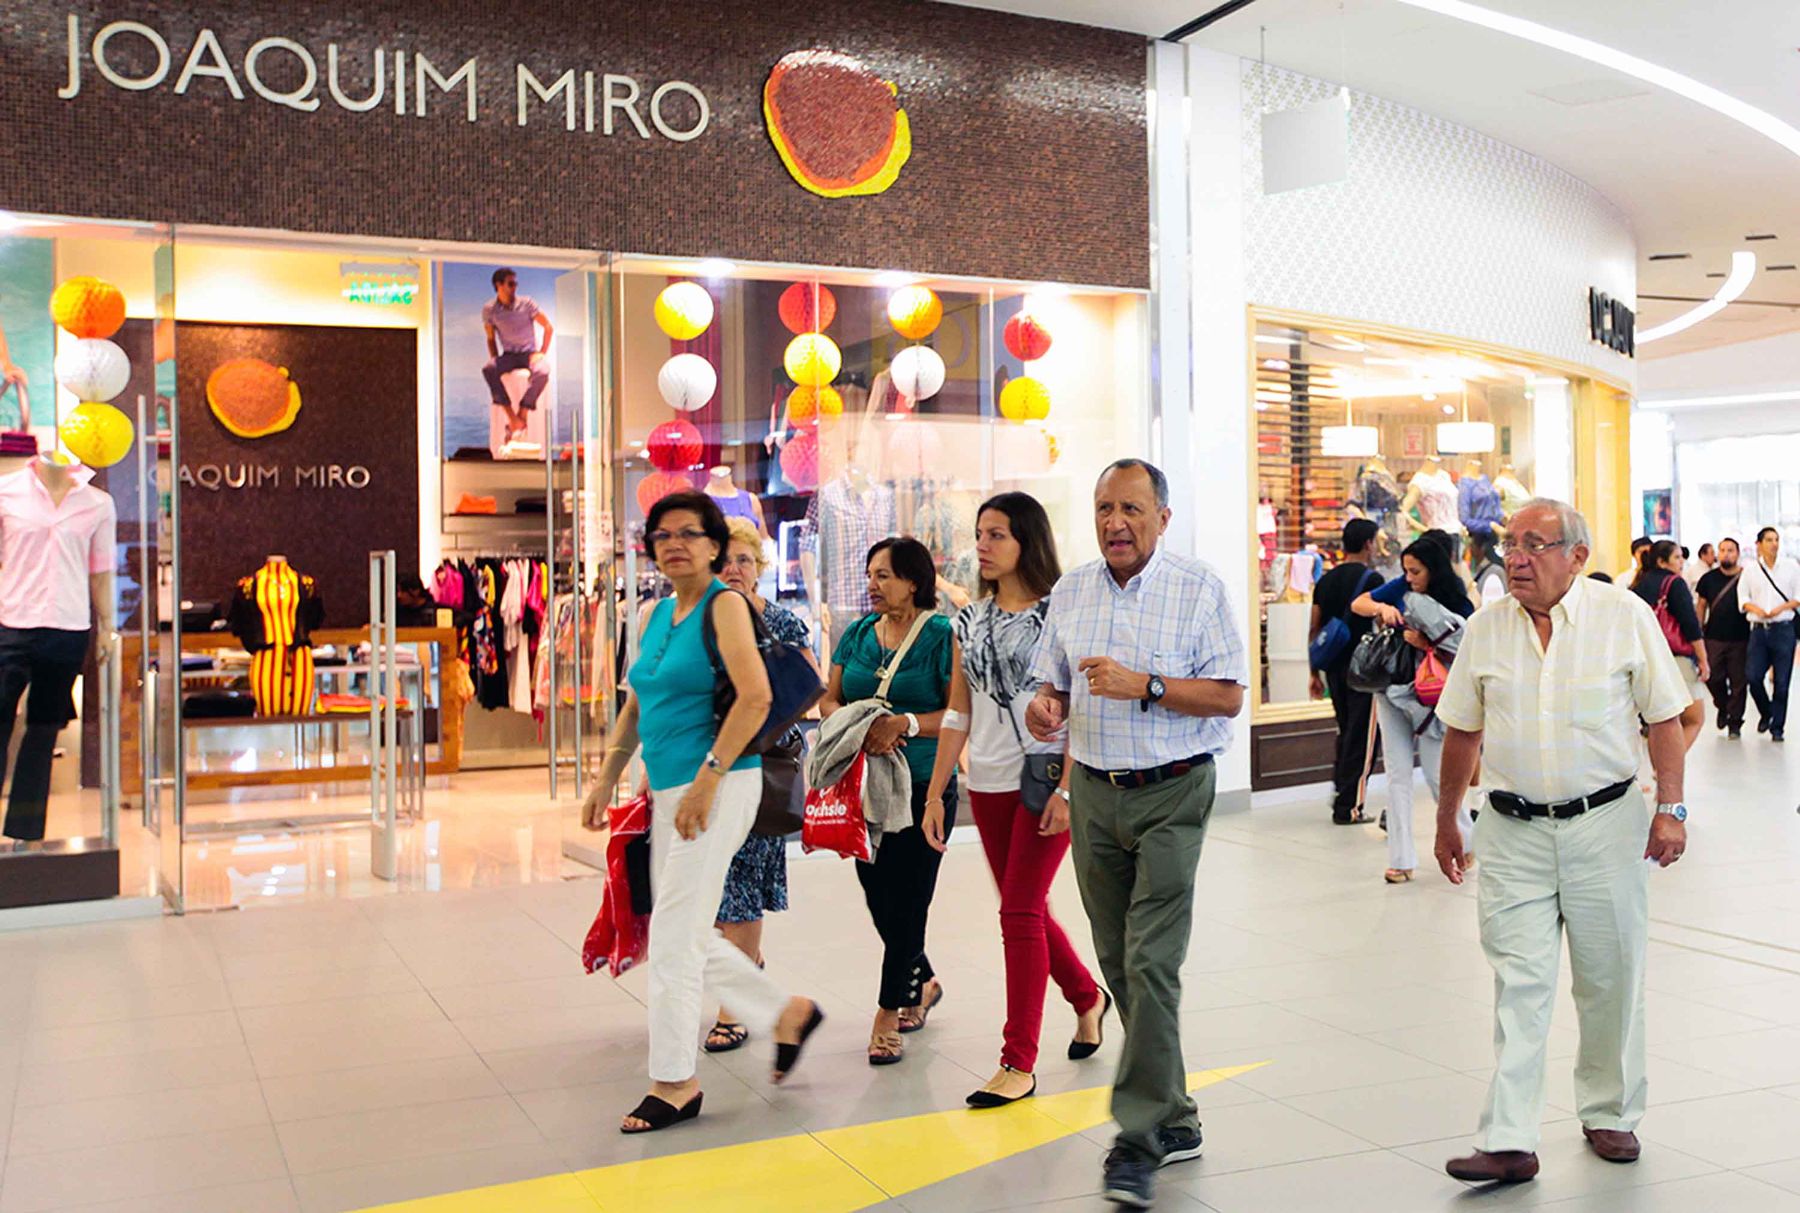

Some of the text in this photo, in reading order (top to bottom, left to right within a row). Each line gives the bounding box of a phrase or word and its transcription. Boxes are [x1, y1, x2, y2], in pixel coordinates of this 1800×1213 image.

[58, 13, 710, 142] JOAQUIM MIRO
[138, 464, 371, 491] AQUIM MIRO
